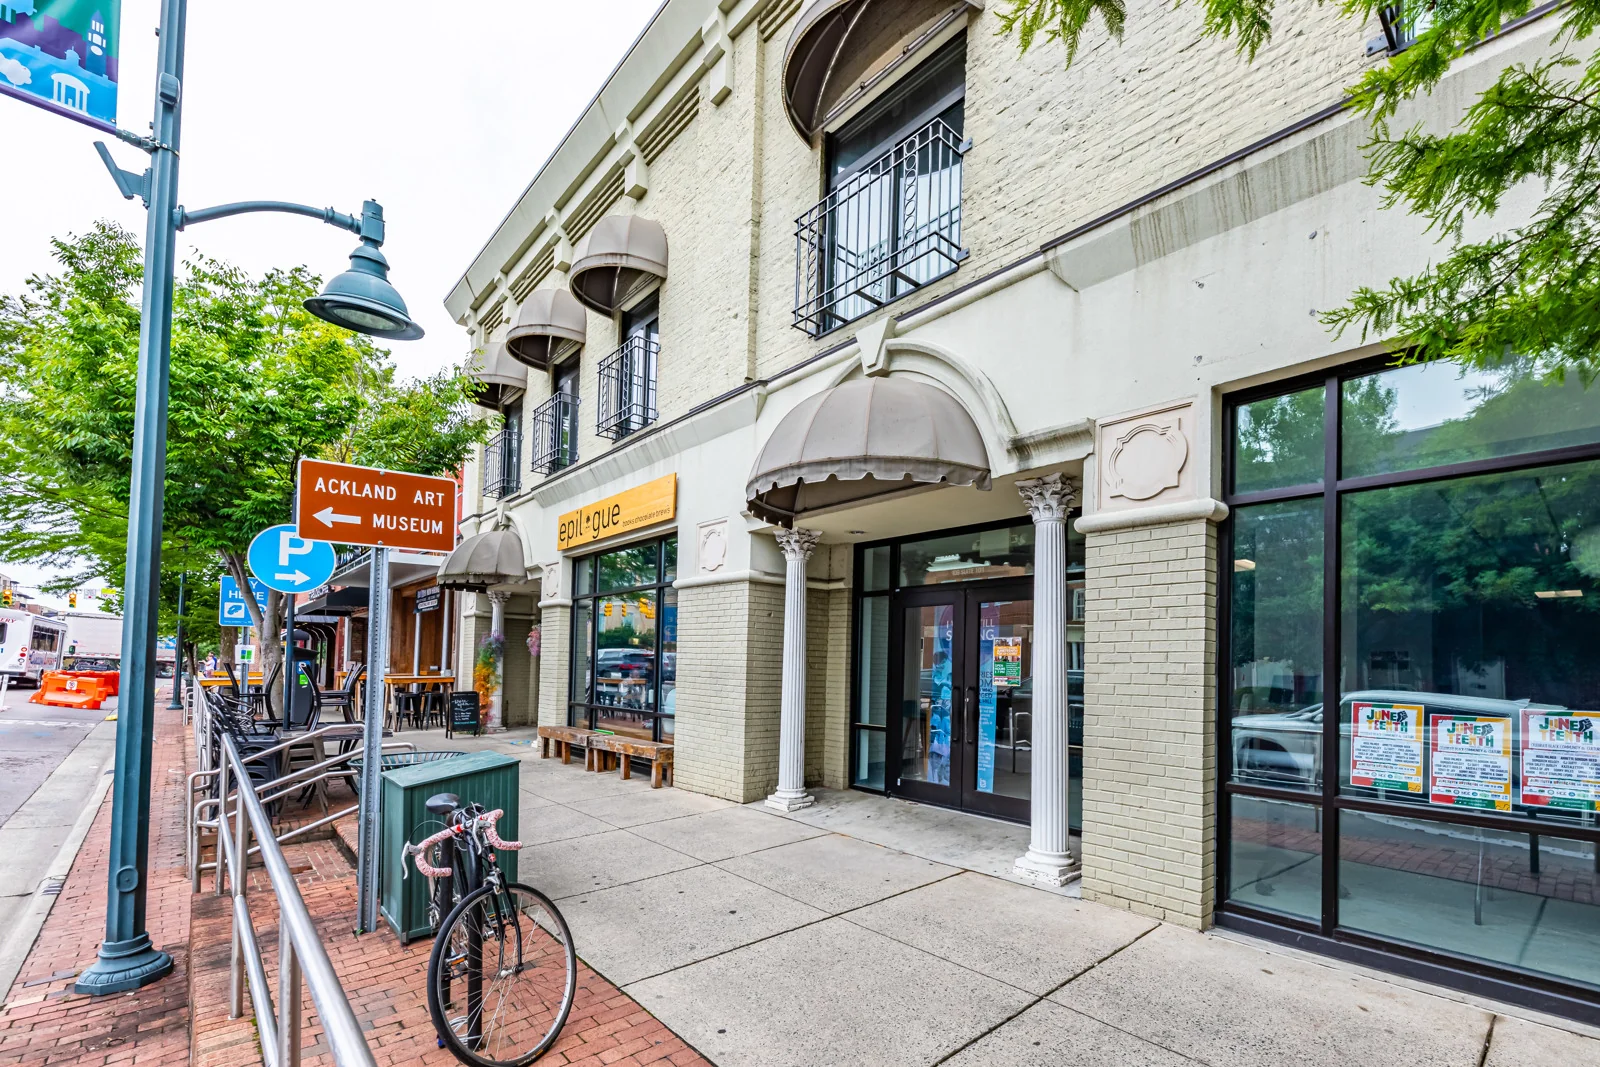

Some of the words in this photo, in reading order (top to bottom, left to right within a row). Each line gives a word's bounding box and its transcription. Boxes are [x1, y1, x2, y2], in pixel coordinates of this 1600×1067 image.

[314, 477, 397, 501] ACKLAND
[413, 490, 445, 507] ART
[372, 513, 443, 535] MUSEUM
[278, 531, 314, 566] P
[228, 590, 265, 600] HEE
[1366, 709, 1397, 721] JUNE
[1366, 719, 1408, 733] TEENTH
[1446, 722, 1482, 735] JUNE
[1539, 717, 1579, 731] JUNE
[1446, 733, 1494, 748] TEENTH
[1538, 729, 1593, 744] TEENTH
